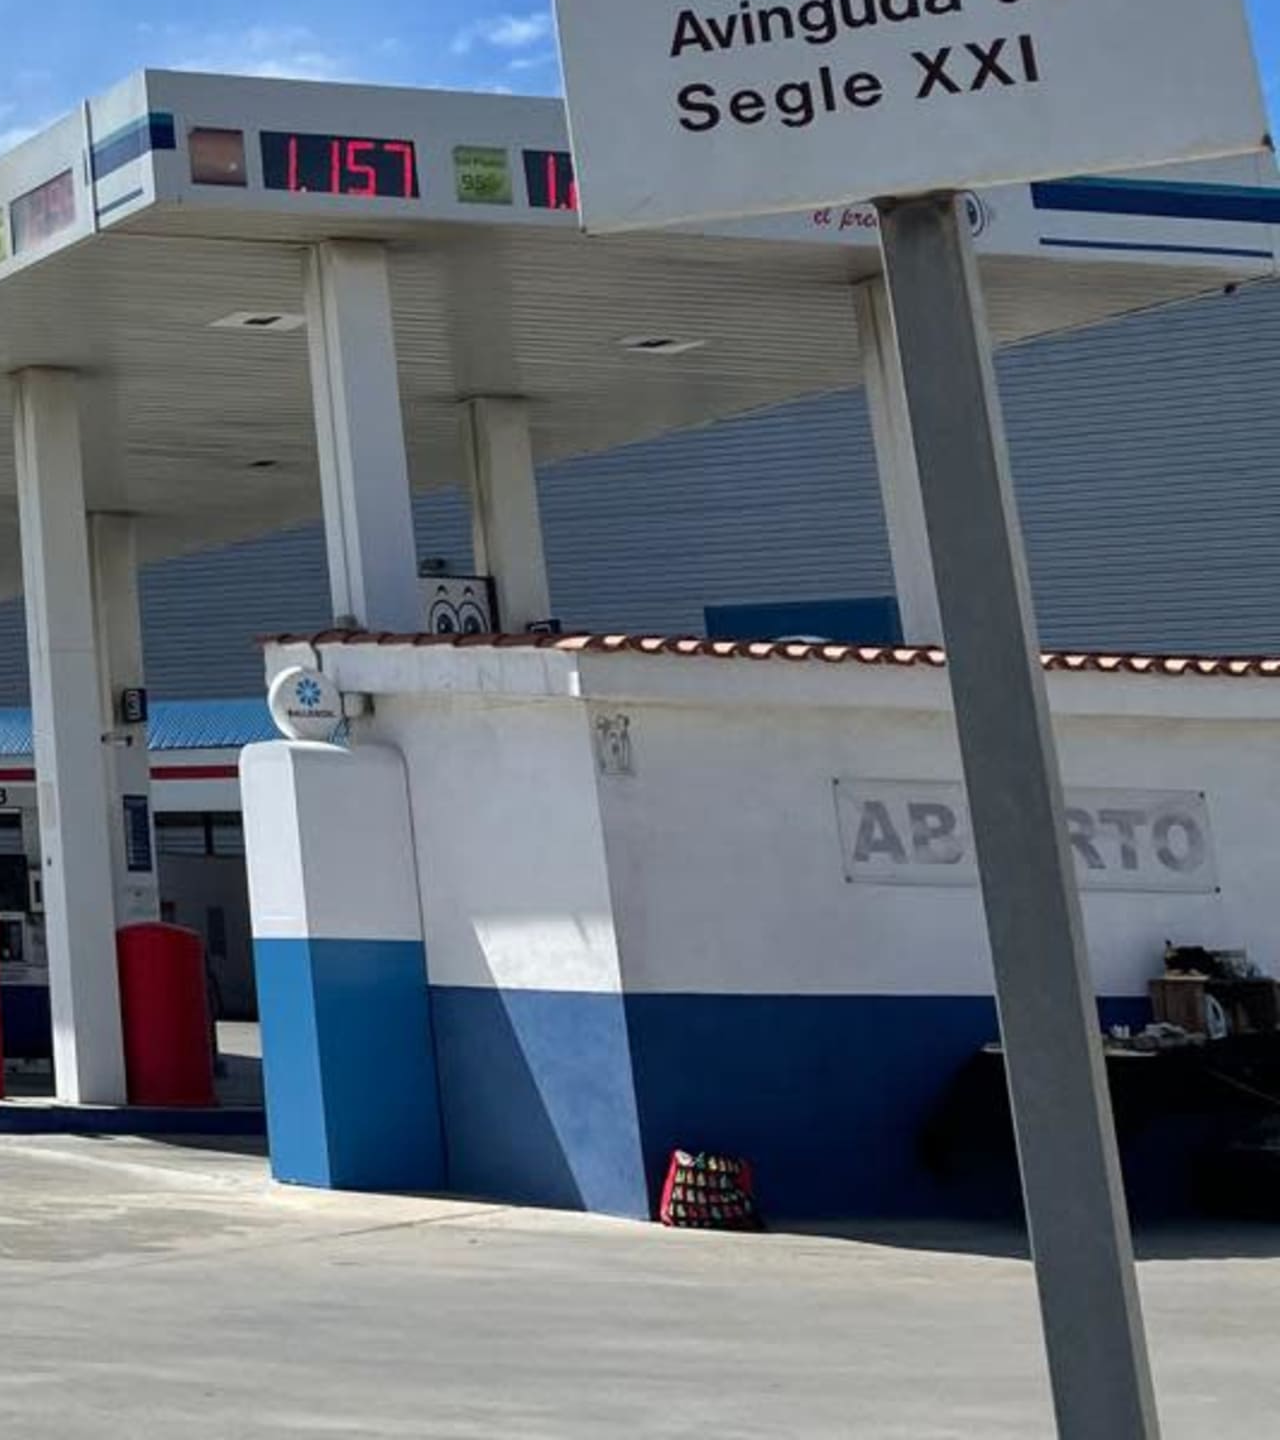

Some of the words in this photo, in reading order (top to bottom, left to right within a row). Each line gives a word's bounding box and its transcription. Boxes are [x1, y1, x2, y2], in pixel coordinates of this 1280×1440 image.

[677, 67, 883, 133] Segle
[911, 34, 1041, 99] XXI
[288, 136, 414, 199] 1.157
[838, 208, 877, 231] pre
[852, 798, 1206, 873] ABRTO
